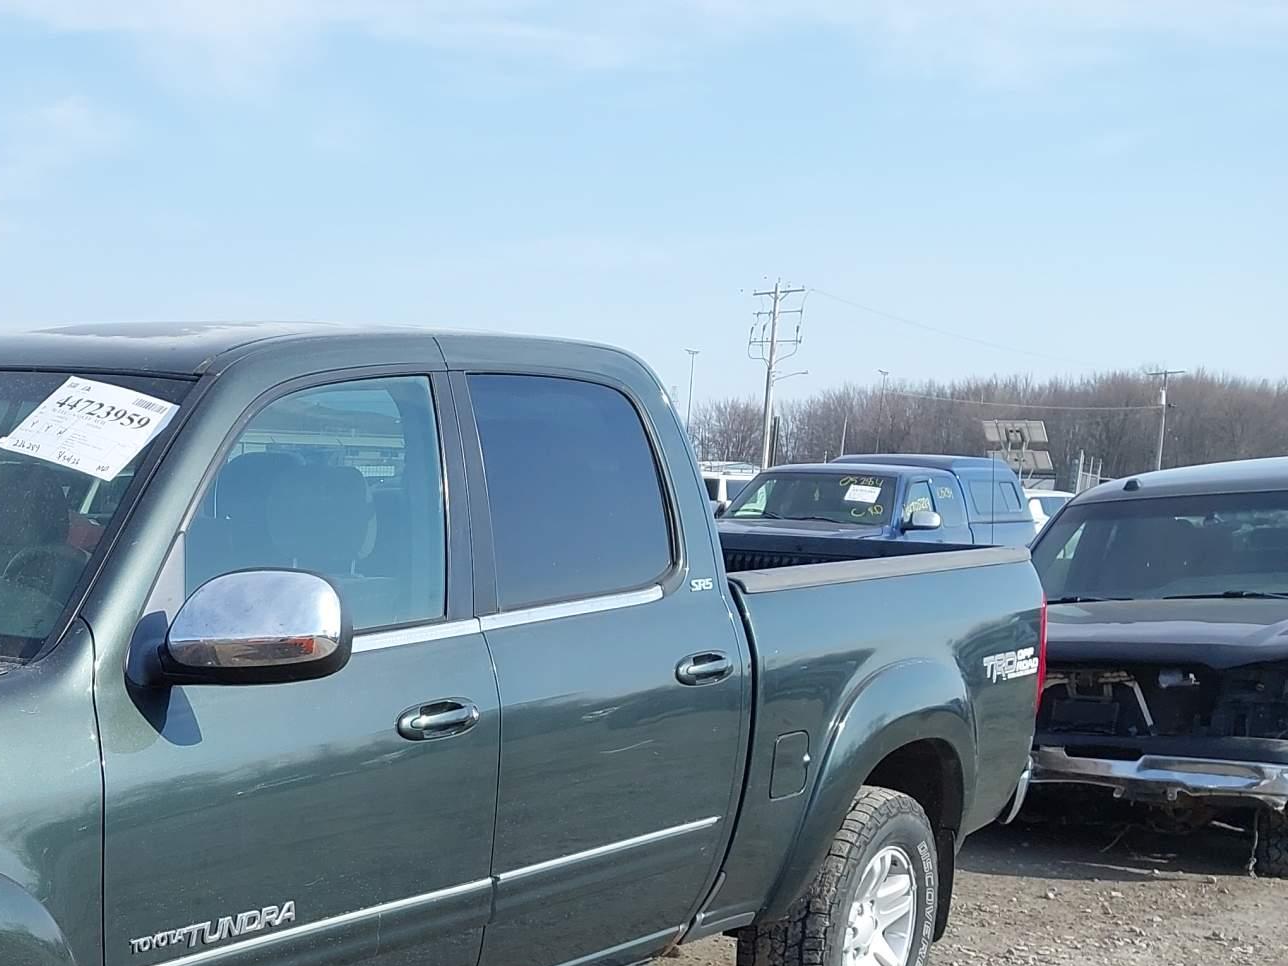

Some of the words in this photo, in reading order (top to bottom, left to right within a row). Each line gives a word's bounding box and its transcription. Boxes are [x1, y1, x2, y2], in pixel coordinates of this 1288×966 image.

[56, 395, 151, 431] 44723959
[690, 578, 713, 592] SR5
[983, 651, 1017, 683] TRD
[1017, 647, 1034, 660] OFF
[1016, 657, 1039, 671] ROAD
[129, 928, 186, 954] TOYOTA
[184, 900, 297, 948] TUNDRA
